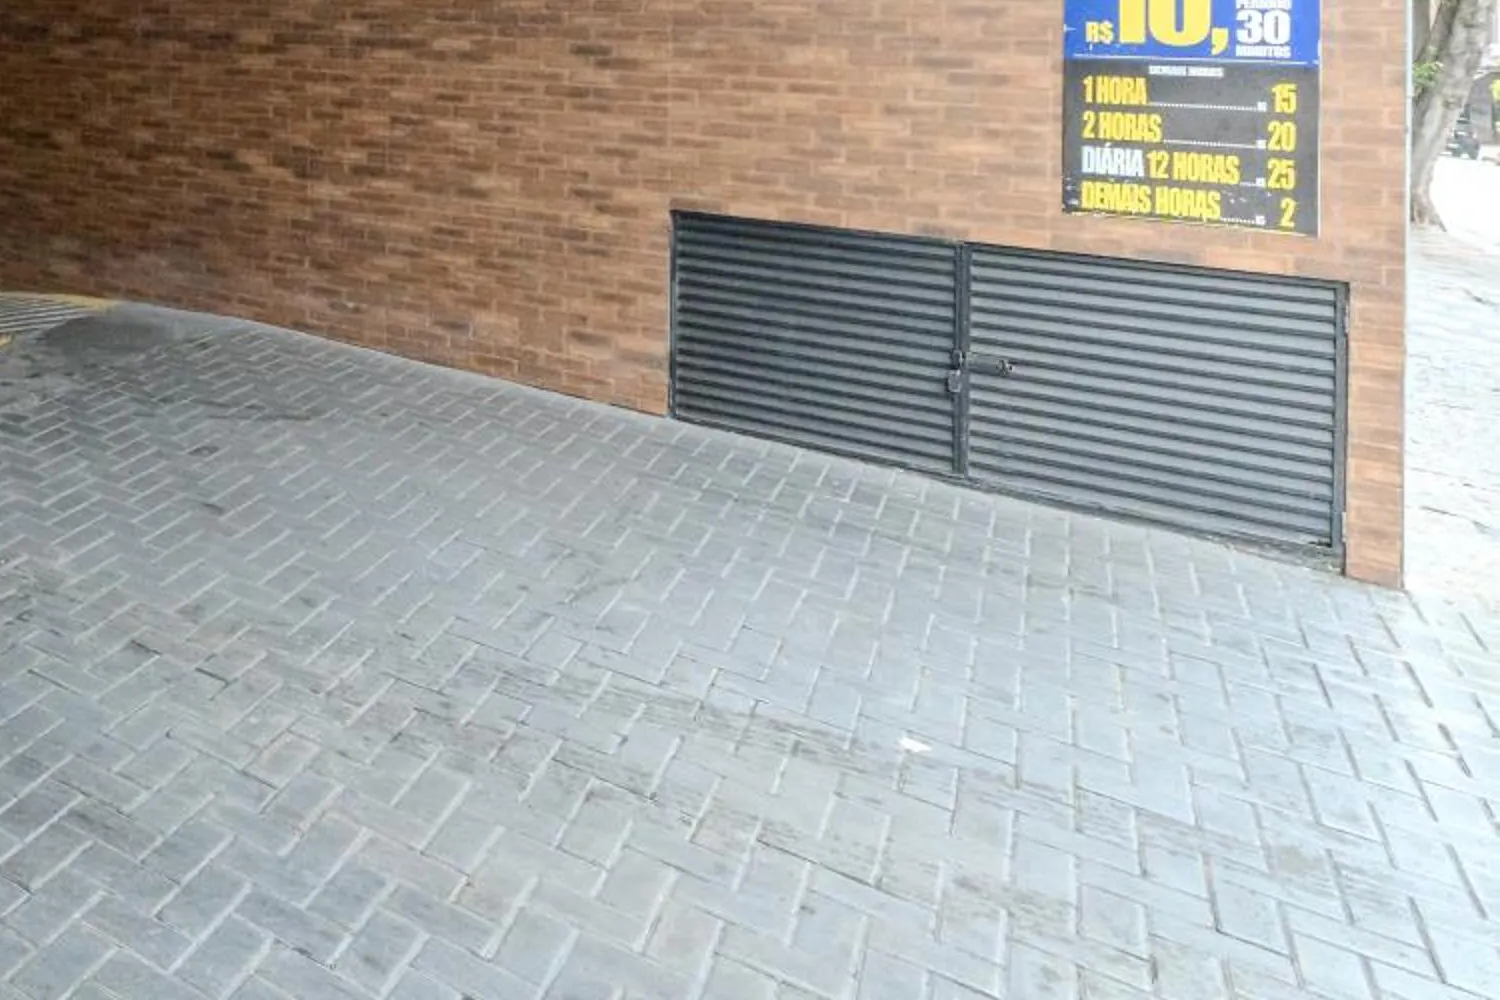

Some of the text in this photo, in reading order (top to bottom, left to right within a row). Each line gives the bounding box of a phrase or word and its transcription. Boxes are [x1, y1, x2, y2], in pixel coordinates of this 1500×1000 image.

[1085, 20, 1114, 45] R$
[1236, 10, 1291, 45] 30
[1083, 75, 1298, 114] 1 HORA 15
[1082, 111, 1297, 152] 2 HORAS 20
[1081, 142, 1296, 190] DIÁRIA 12 HORAS 25
[1081, 181, 1296, 229] DEMAIS HORAS 2
